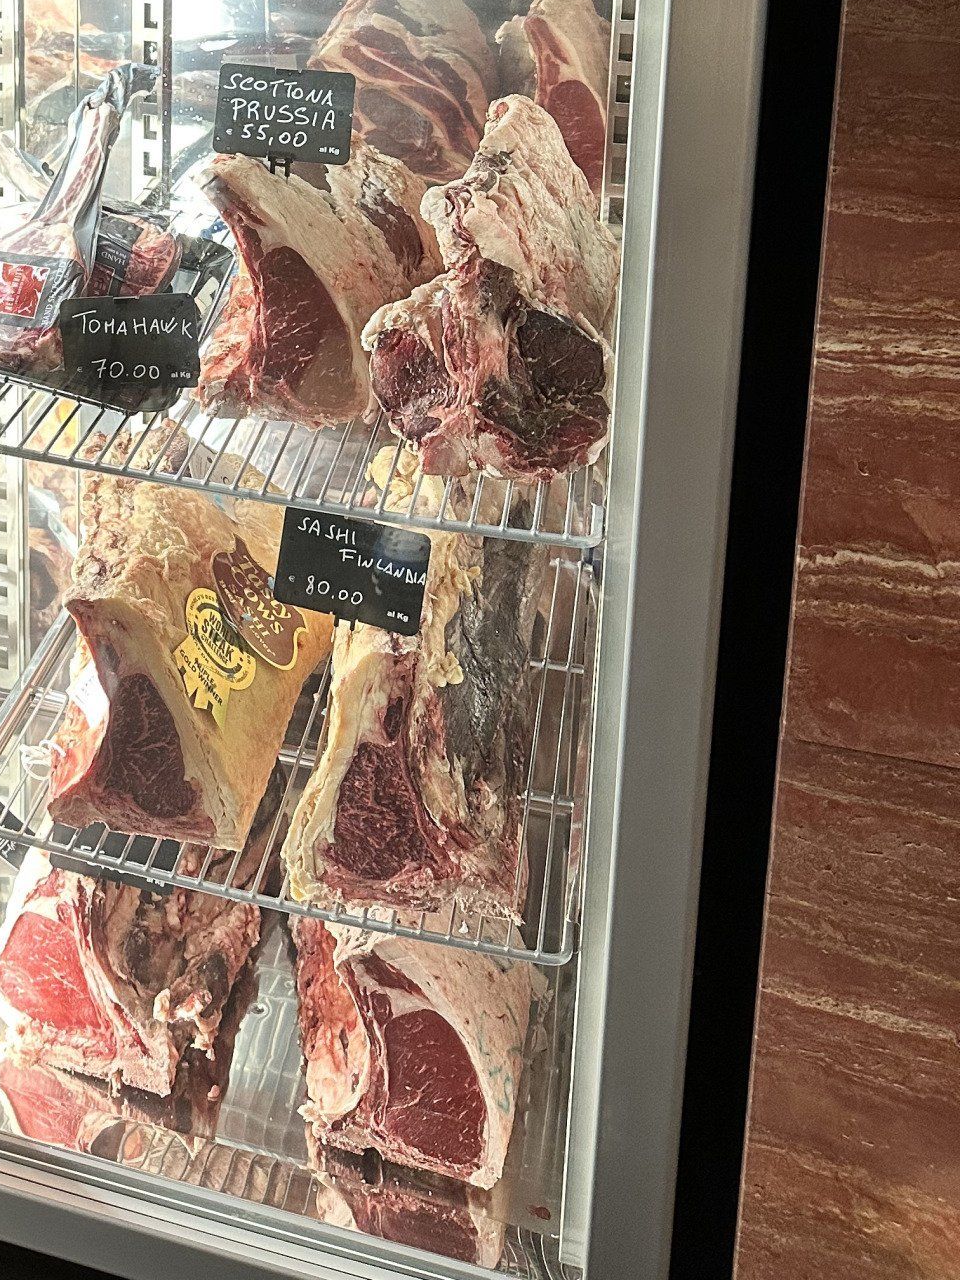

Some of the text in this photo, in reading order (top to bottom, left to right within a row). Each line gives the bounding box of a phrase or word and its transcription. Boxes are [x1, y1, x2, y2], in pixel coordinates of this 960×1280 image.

[223, 73, 334, 107] SCOTTONA
[230, 97, 336, 131] PRUSSIA
[240, 123, 308, 148] 55,00
[328, 146, 340, 156] Kg
[100, 250, 127, 266] HAND
[72, 310, 194, 339] TOMAHAWK
[91, 358, 161, 381] 70.00
[180, 370, 191, 380] Kg
[297, 516, 357, 546] SASHI
[338, 548, 427, 586] FINLANDIA
[239, 554, 292, 620] Tasty
[304, 574, 364, 606] 80.00
[386, 610, 396, 618] al
[396, 610, 410, 623] Kg
[229, 583, 272, 638] SASHI
[201, 618, 235, 663] STEAK
[179, 649, 198, 674] GOLD
[197, 671, 224, 707] WINNER
